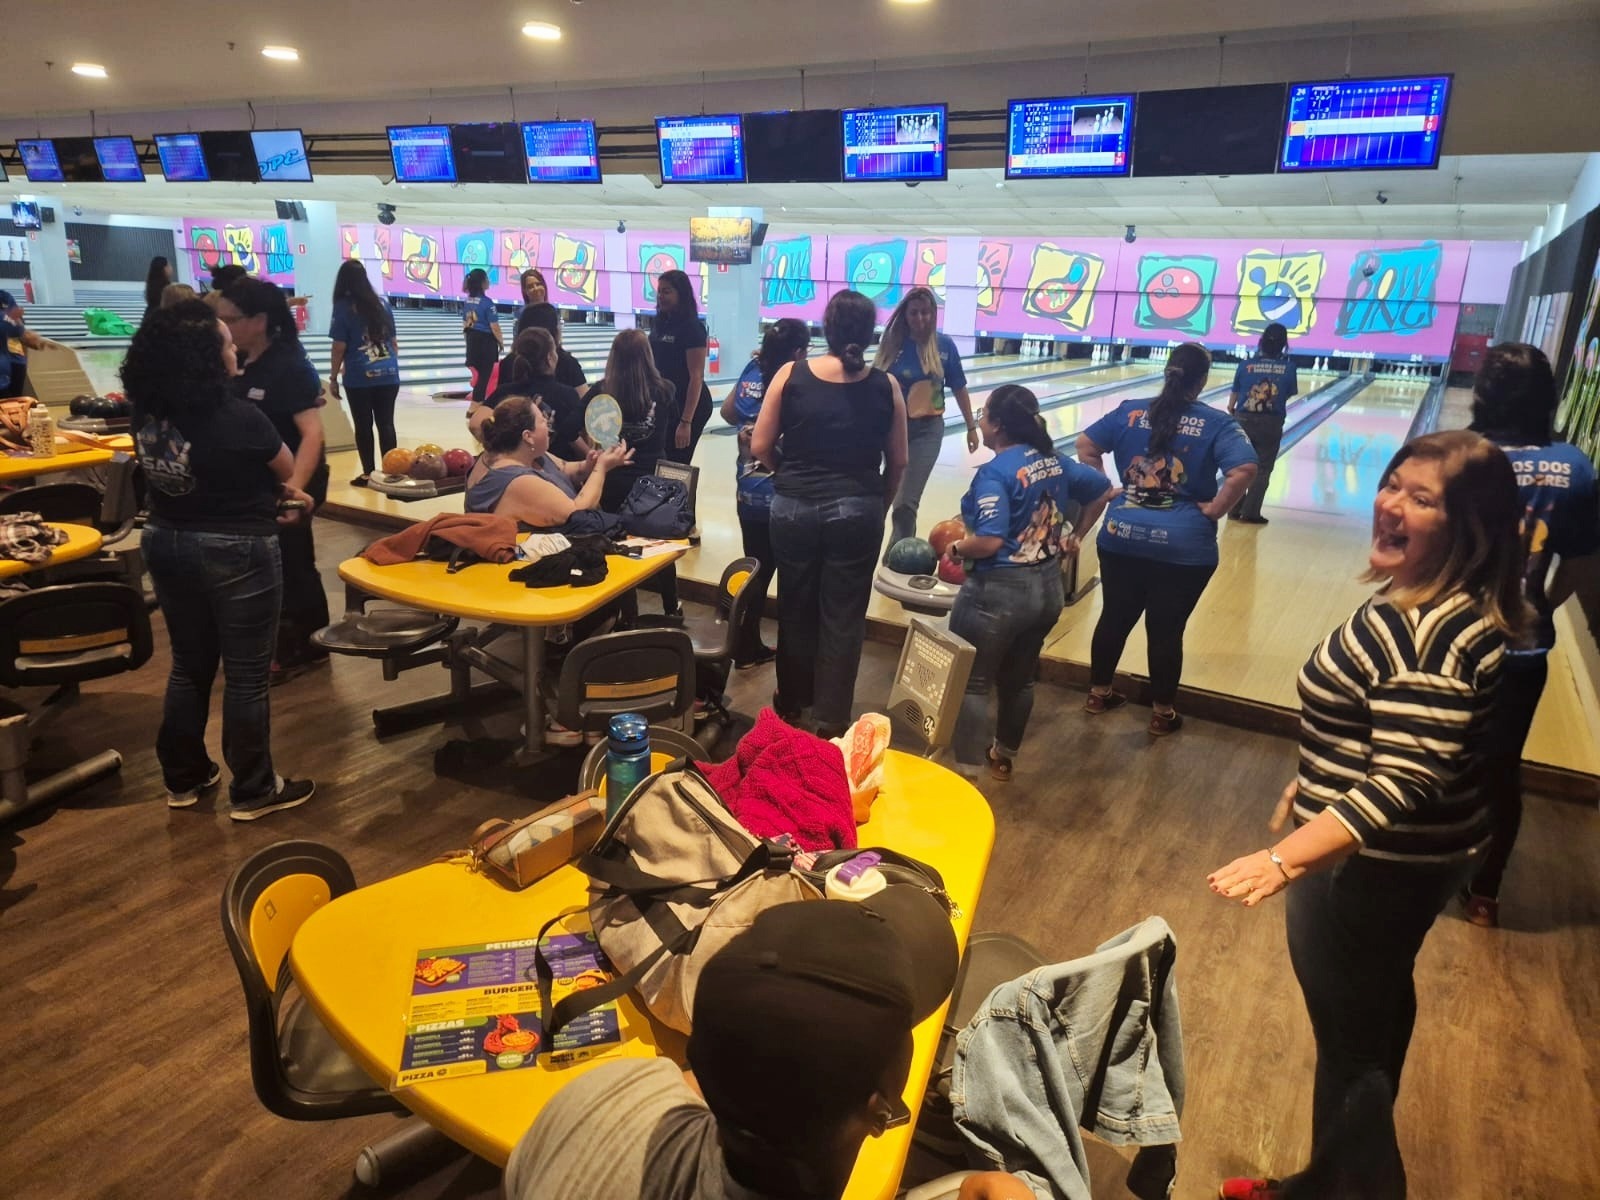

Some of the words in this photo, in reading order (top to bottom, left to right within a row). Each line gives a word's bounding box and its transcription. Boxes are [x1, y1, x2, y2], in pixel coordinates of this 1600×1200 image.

[1180, 415, 1206, 428] DOS
[1538, 460, 1571, 475] DOS
[416, 1018, 465, 1033] PIZZAS
[402, 1071, 434, 1082] PIZZA
